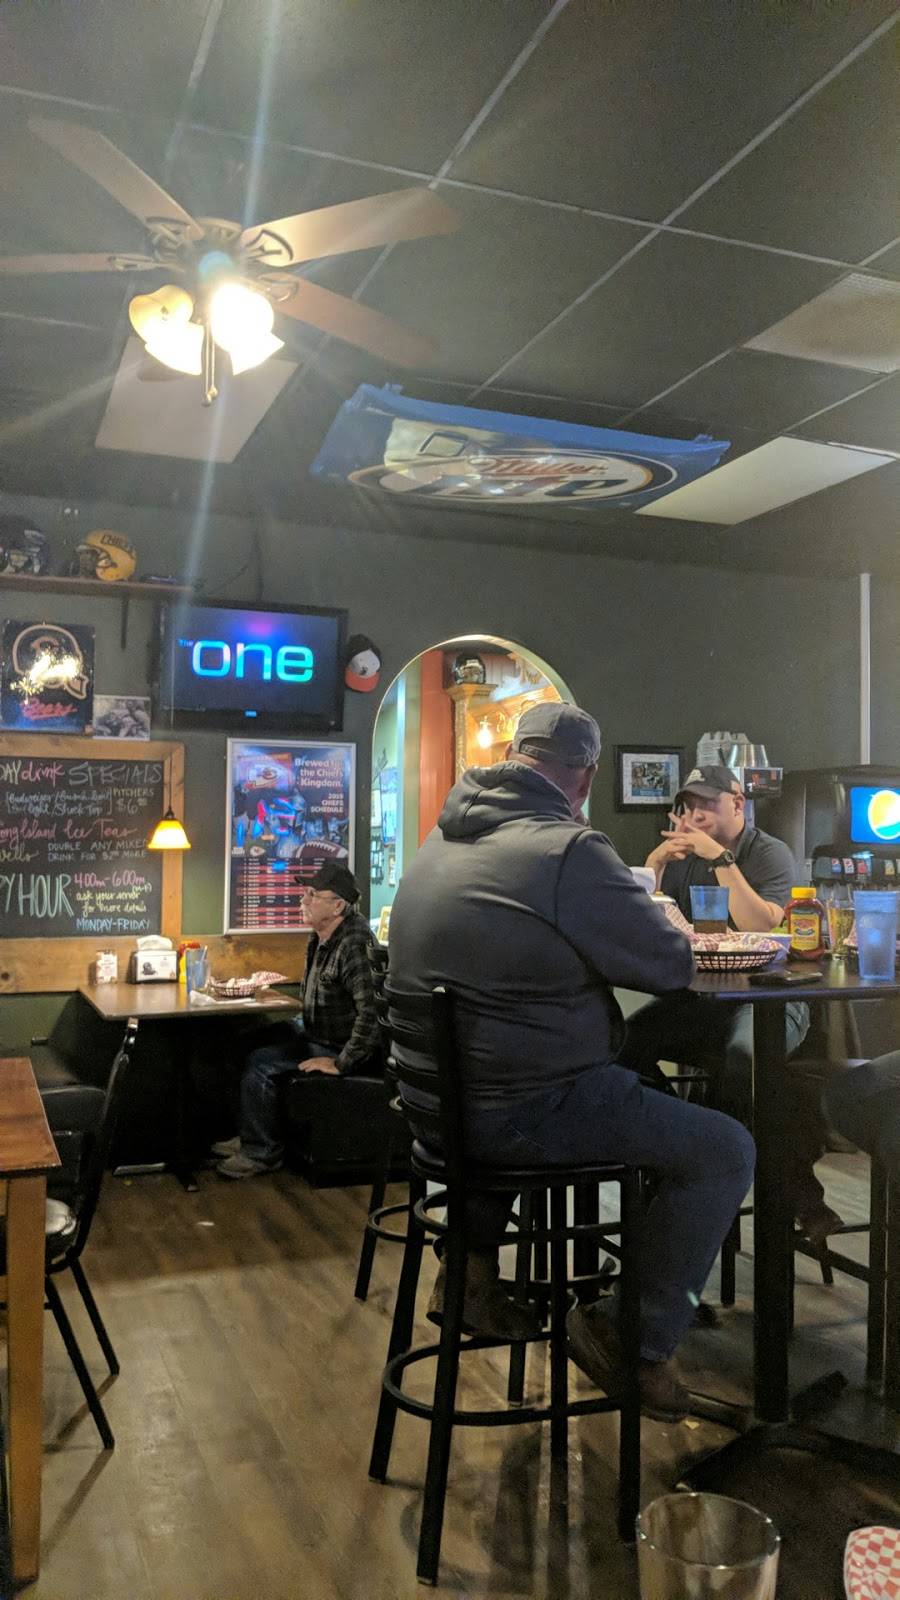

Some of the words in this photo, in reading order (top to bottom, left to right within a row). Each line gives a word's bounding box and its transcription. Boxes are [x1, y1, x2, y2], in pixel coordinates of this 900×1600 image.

[192, 639, 314, 683] one
[294, 758, 330, 768] Brewed
[21, 761, 65, 788] drink
[69, 761, 162, 787] SPECIALS
[300, 768, 316, 777] the
[113, 787, 155, 799] PITCHERS
[48, 842, 80, 851] DOUBLE
[90, 841, 112, 850] ANY
[48, 852, 73, 862] DRINK
[17, 873, 75, 918] HOUR
[76, 917, 151, 933] MONDAY-FRIDAY
